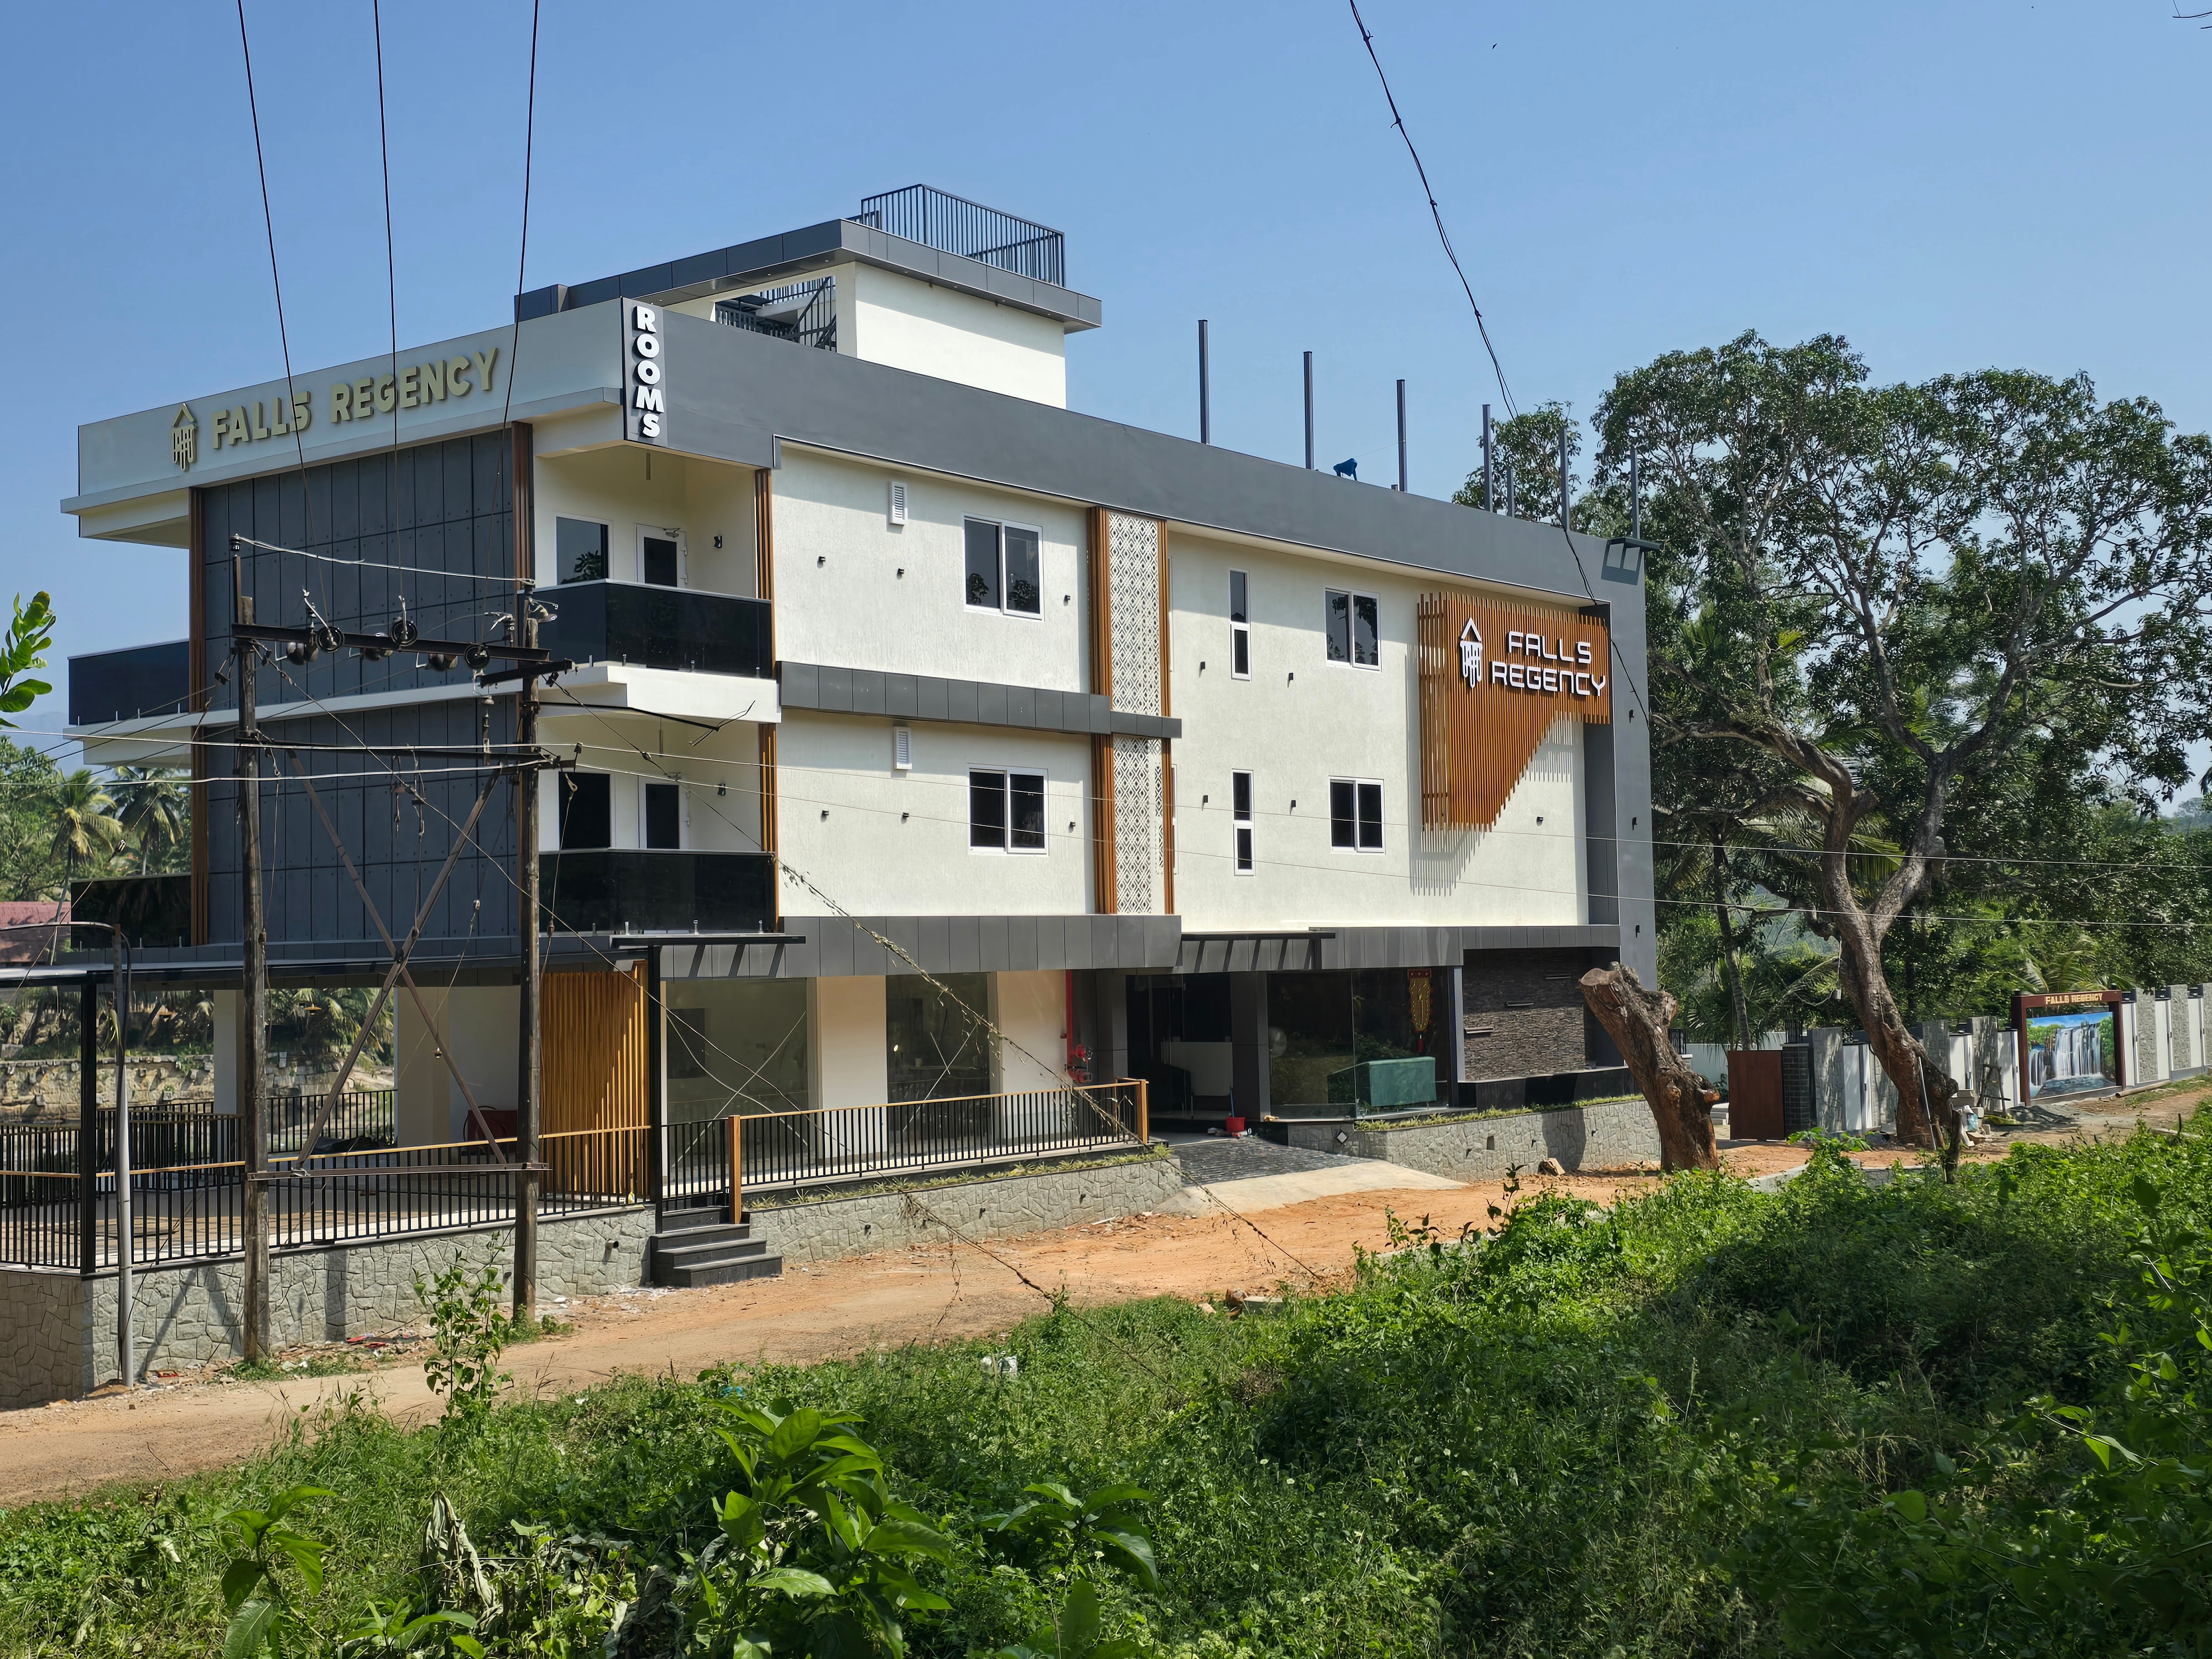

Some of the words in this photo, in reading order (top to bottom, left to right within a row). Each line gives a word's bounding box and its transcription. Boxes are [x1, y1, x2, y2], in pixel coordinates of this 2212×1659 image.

[635, 305, 664, 439] ROOMS
[212, 390, 311, 449] FALLS
[330, 347, 498, 422] REGENCY
[1508, 630, 1592, 664] FALLS
[1491, 660, 1606, 697] REGENCY
[2046, 995, 2069, 1004] FALLS
